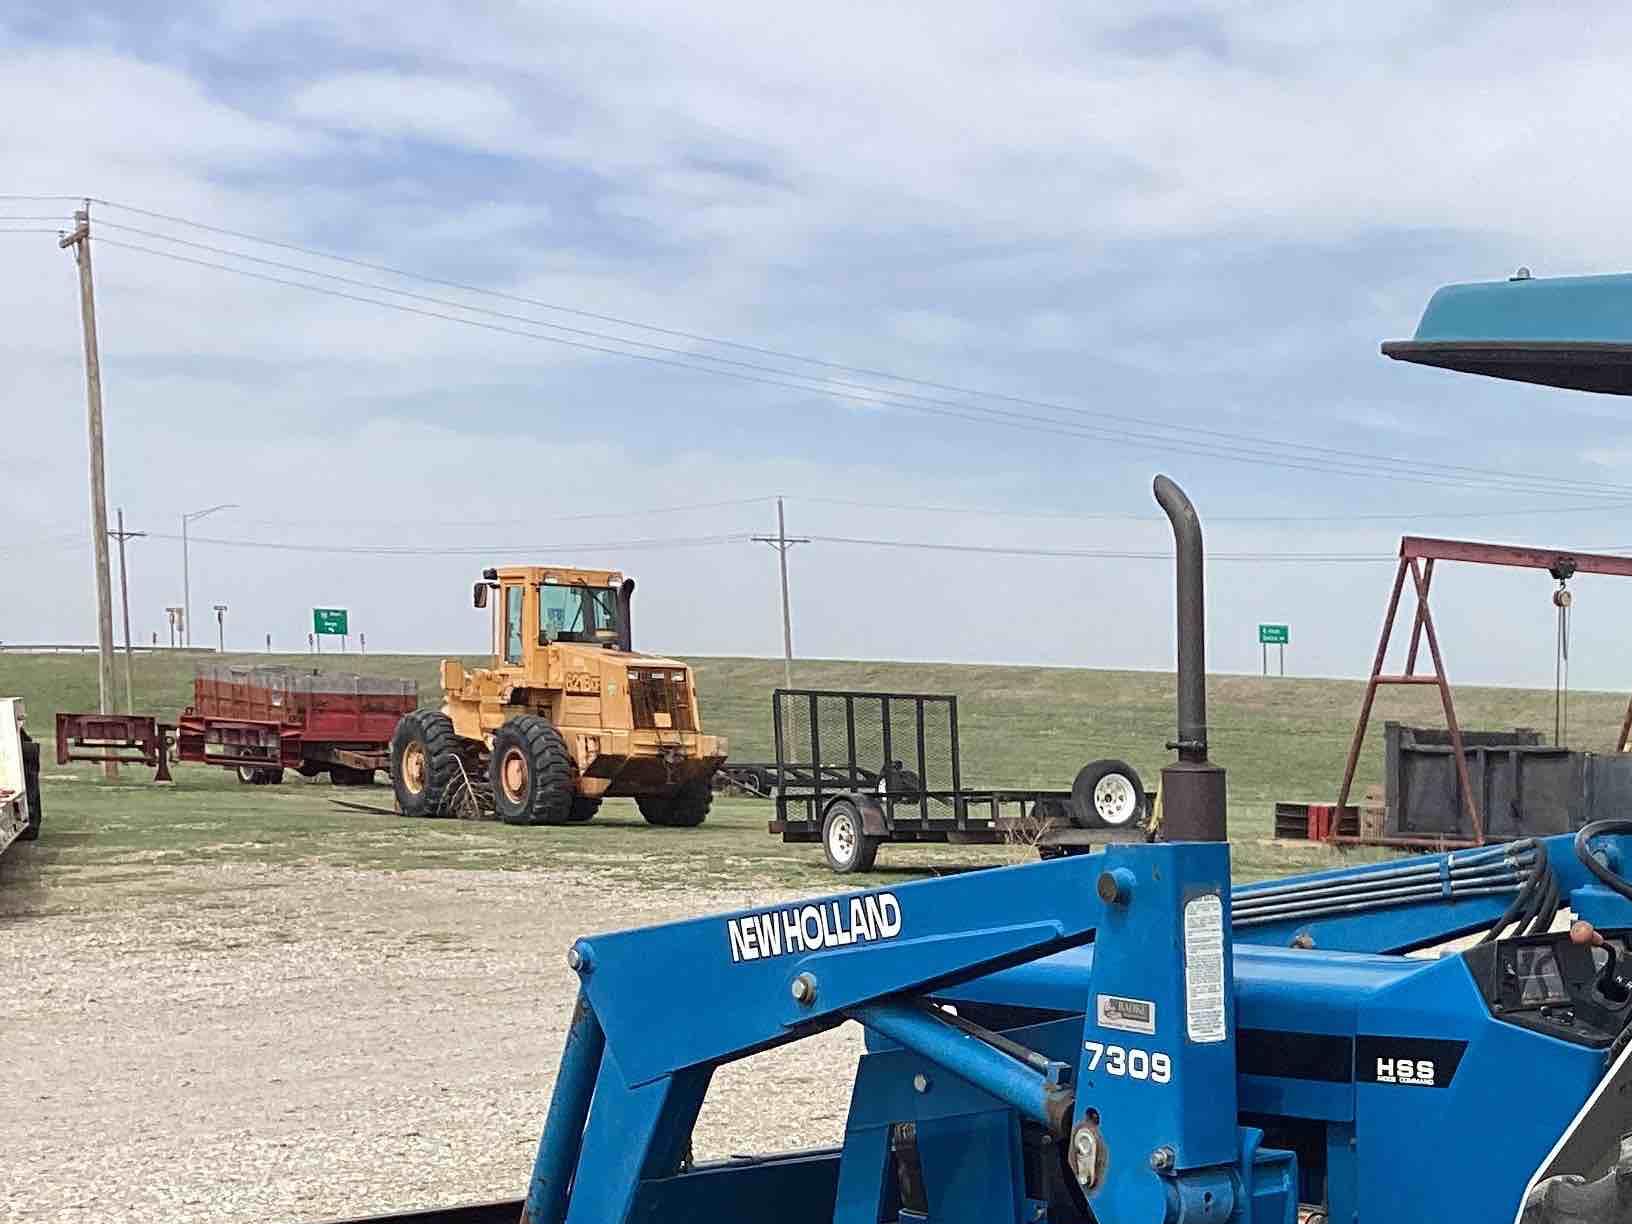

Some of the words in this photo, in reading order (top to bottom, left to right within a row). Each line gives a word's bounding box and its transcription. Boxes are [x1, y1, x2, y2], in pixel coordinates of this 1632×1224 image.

[727, 912, 782, 962] NEW
[782, 892, 902, 953] HOLLAND
[1084, 1041, 1172, 1085] 7309
[1376, 1057, 1435, 1079] HSS
